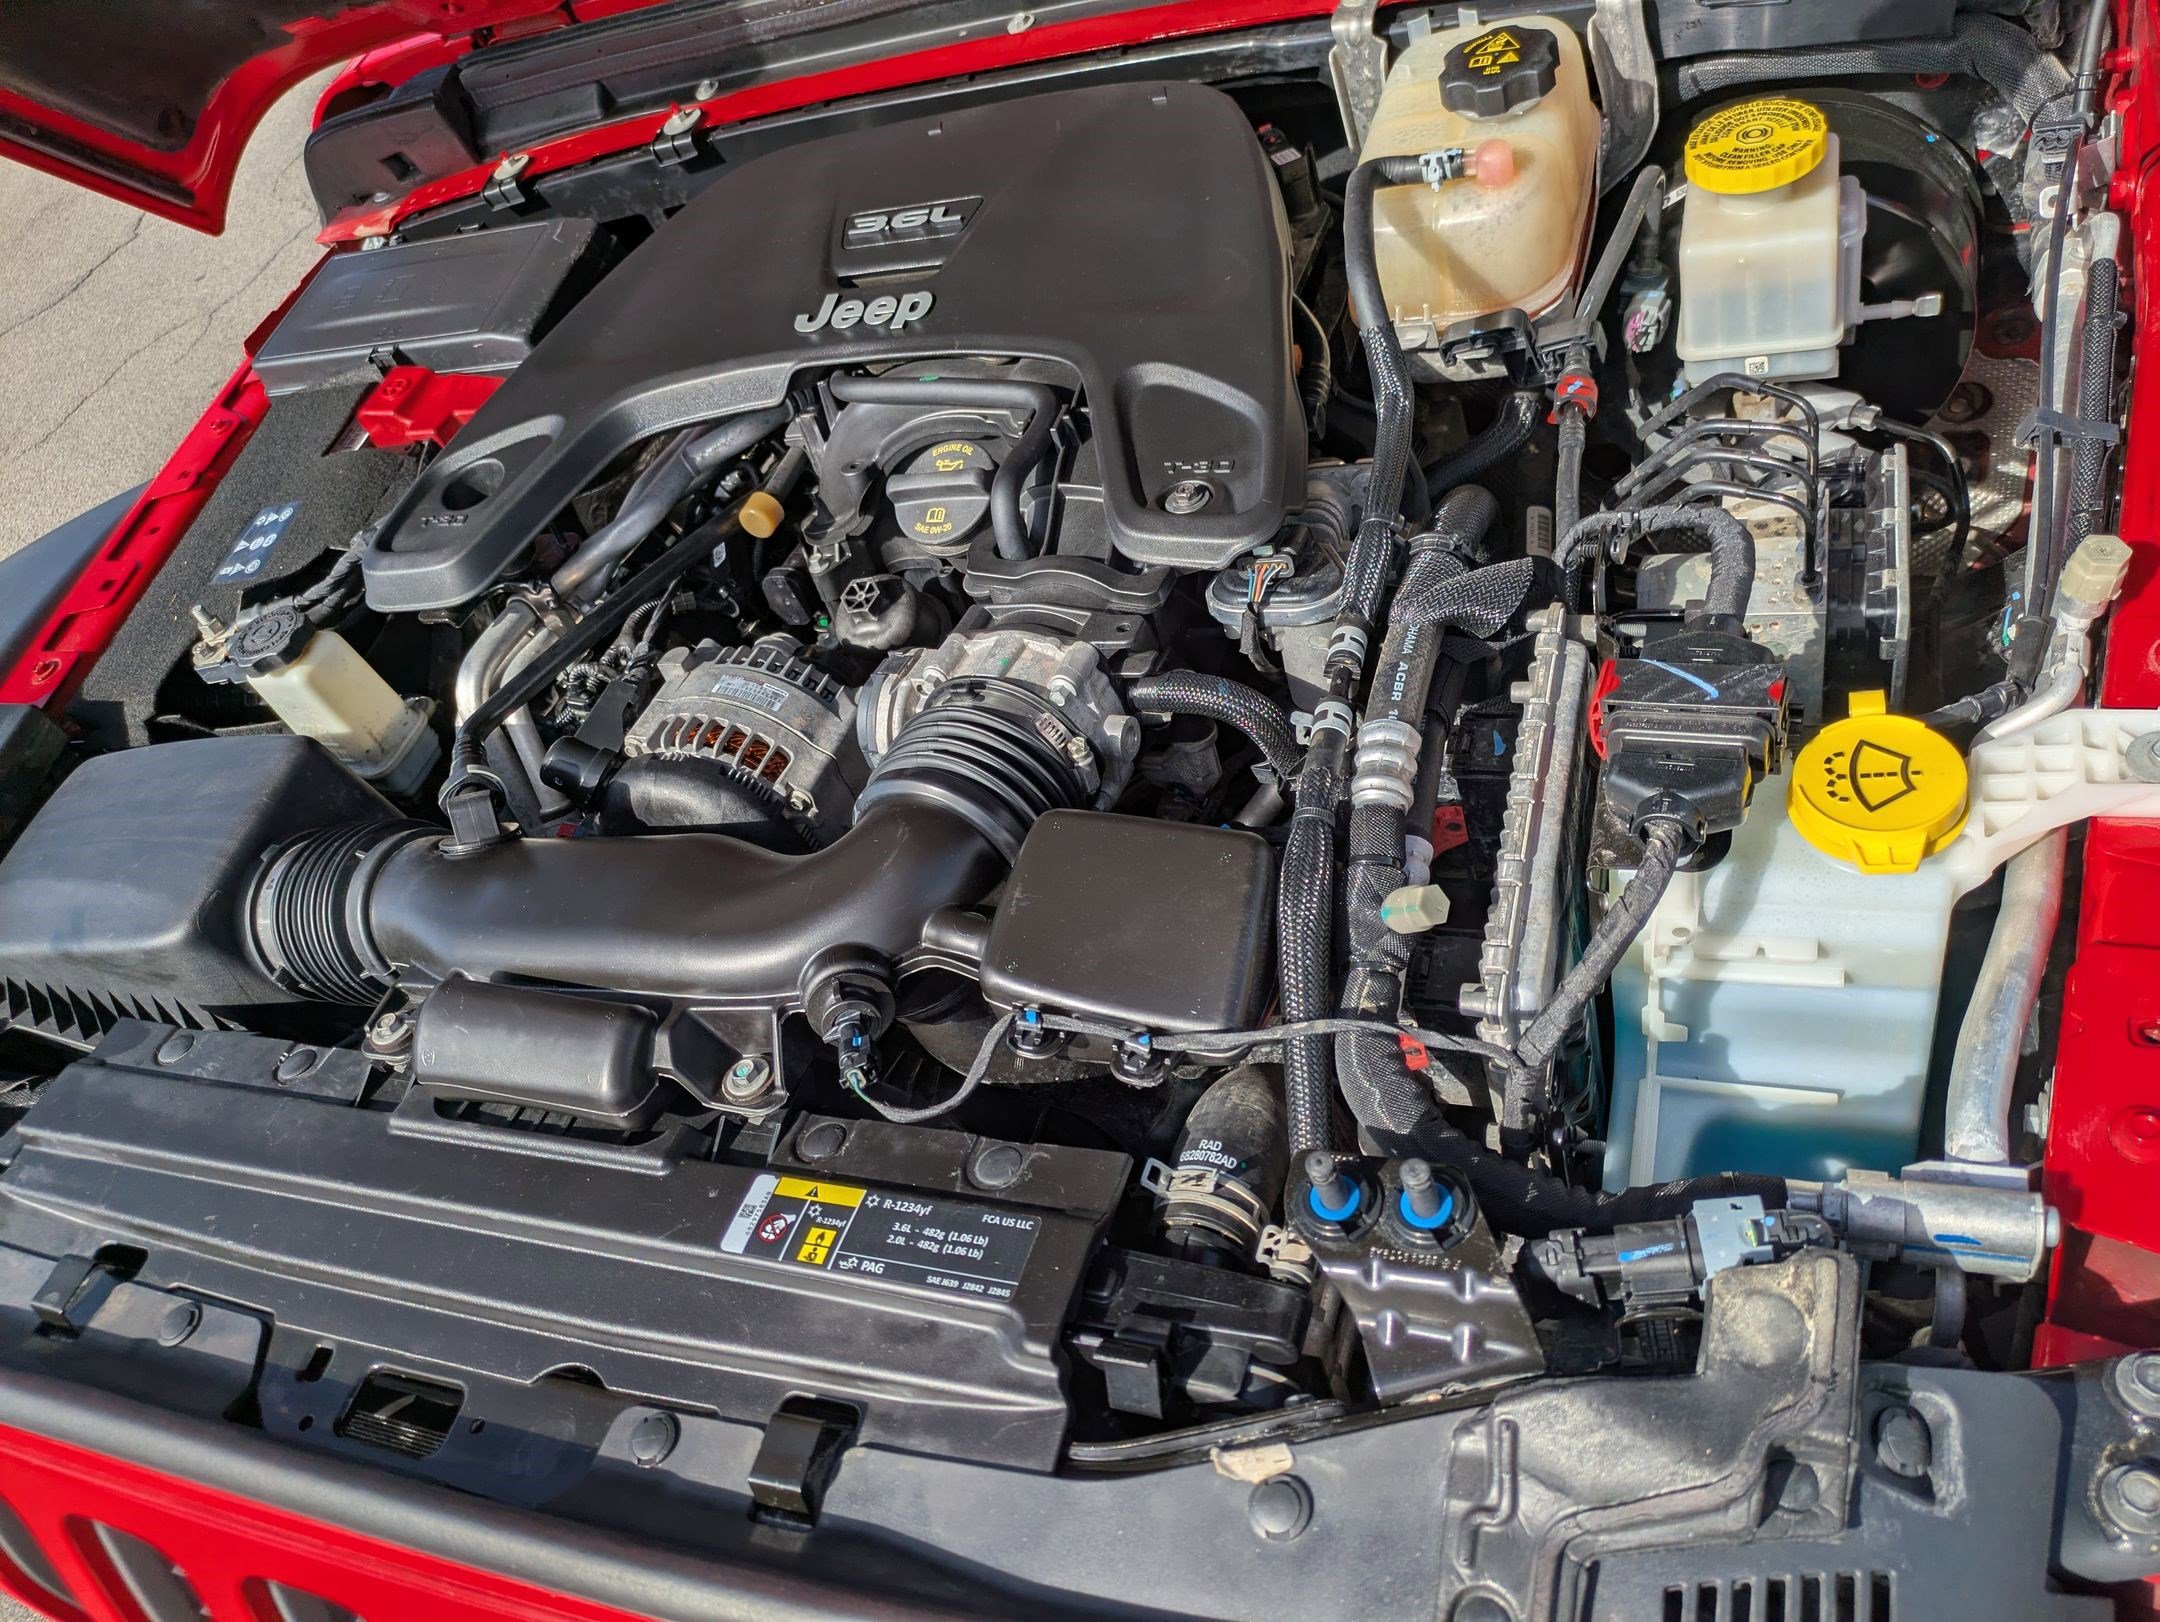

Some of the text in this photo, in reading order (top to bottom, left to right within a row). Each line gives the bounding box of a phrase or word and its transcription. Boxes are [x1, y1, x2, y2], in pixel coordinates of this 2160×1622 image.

[1719, 151, 1742, 159] CLEAN
[848, 205, 963, 237] 3.6L
[793, 290, 935, 333] Jeep
[932, 443, 974, 457] ENGINE OIL
[914, 522, 952, 535] SAE 0W-20
[1390, 660, 1409, 702] ACBR
[1198, 1139, 1223, 1152] RAD
[1179, 1149, 1238, 1170] 68280782AD
[883, 1198, 934, 1217] R-1234yf
[815, 1216, 848, 1229] R-1234yf
[982, 1214, 1035, 1231] FCA US LLC
[891, 1222, 911, 1234] 3.6L
[922, 1226, 946, 1240] 482g
[947, 1230, 973, 1244] (1.06
[972, 1234, 990, 1248] Lb)
[886, 1234, 906, 1246] 2.0L
[916, 1239, 940, 1253] 482g
[942, 1243, 968, 1257] (1.06
[967, 1247, 984, 1260] Lb)
[860, 1260, 886, 1275] PAG
[925, 1275, 942, 1285] SAE
